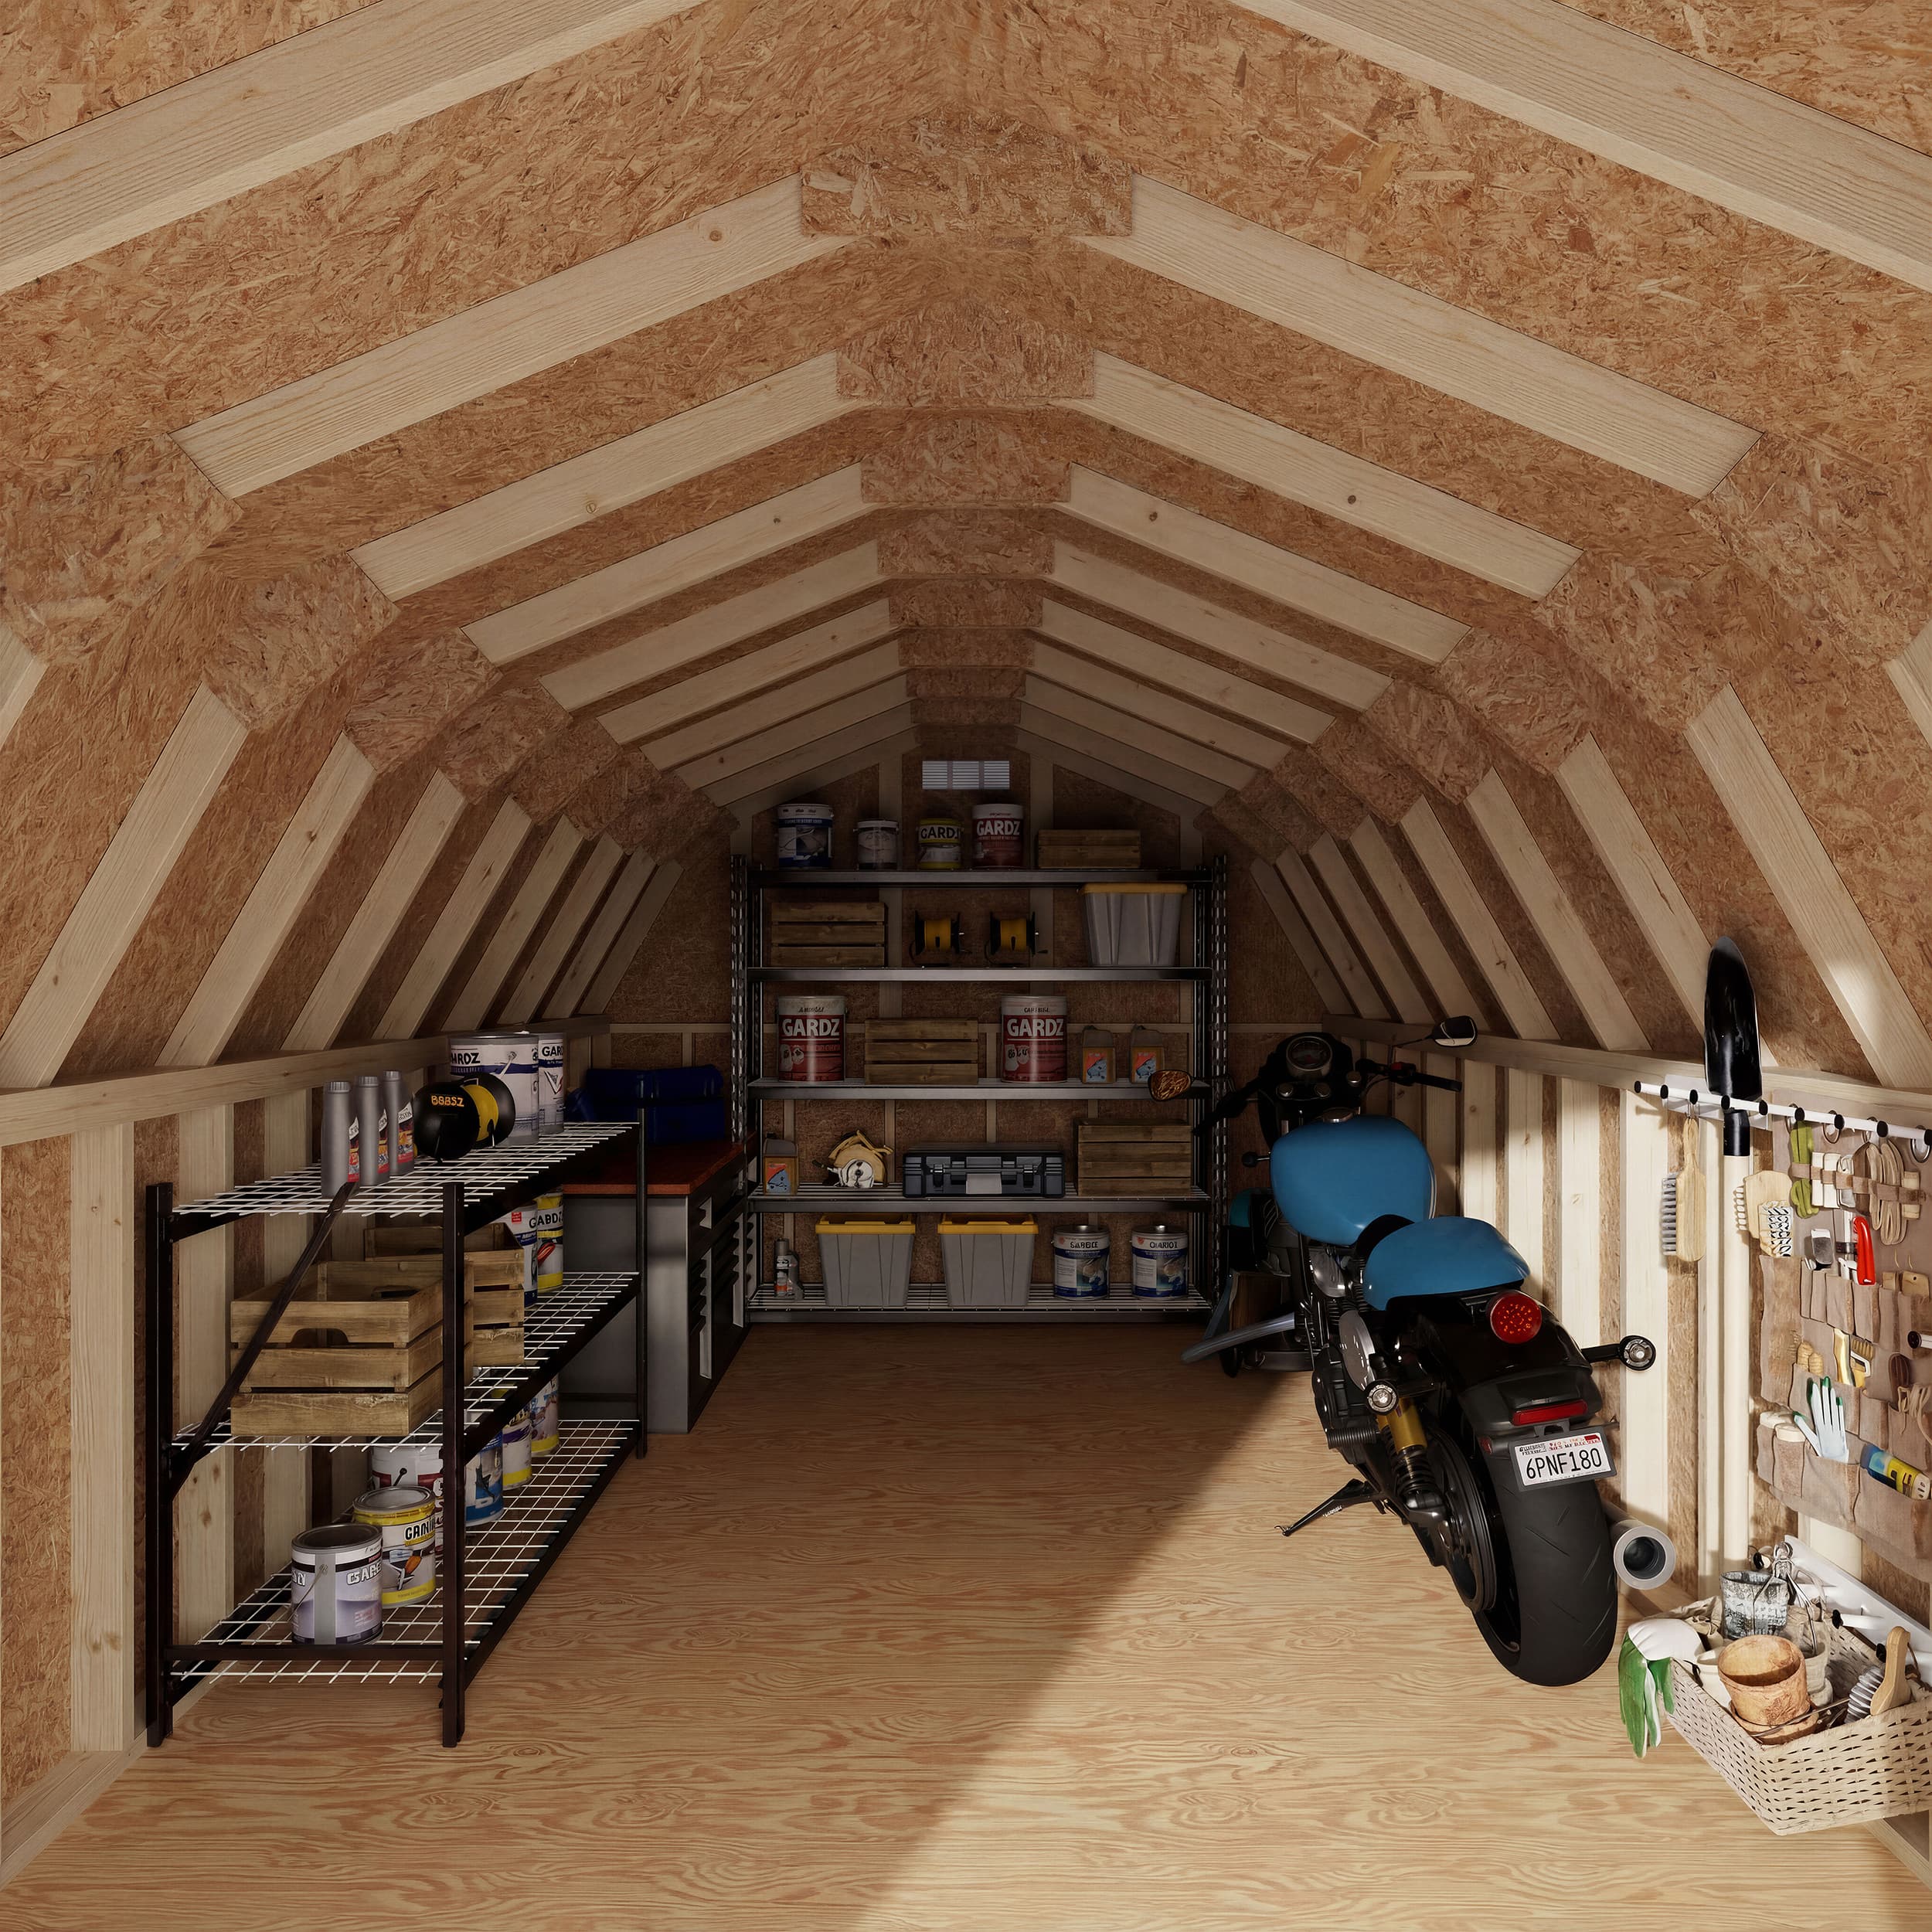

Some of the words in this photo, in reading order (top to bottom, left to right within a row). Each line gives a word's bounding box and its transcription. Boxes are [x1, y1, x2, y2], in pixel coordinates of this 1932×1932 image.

[976, 820, 1021, 835] GARDZ
[782, 1019, 840, 1036] GARDZ
[1007, 1018, 1064, 1037] GARDZ
[1526, 1447, 1602, 1479] 6PNF180
